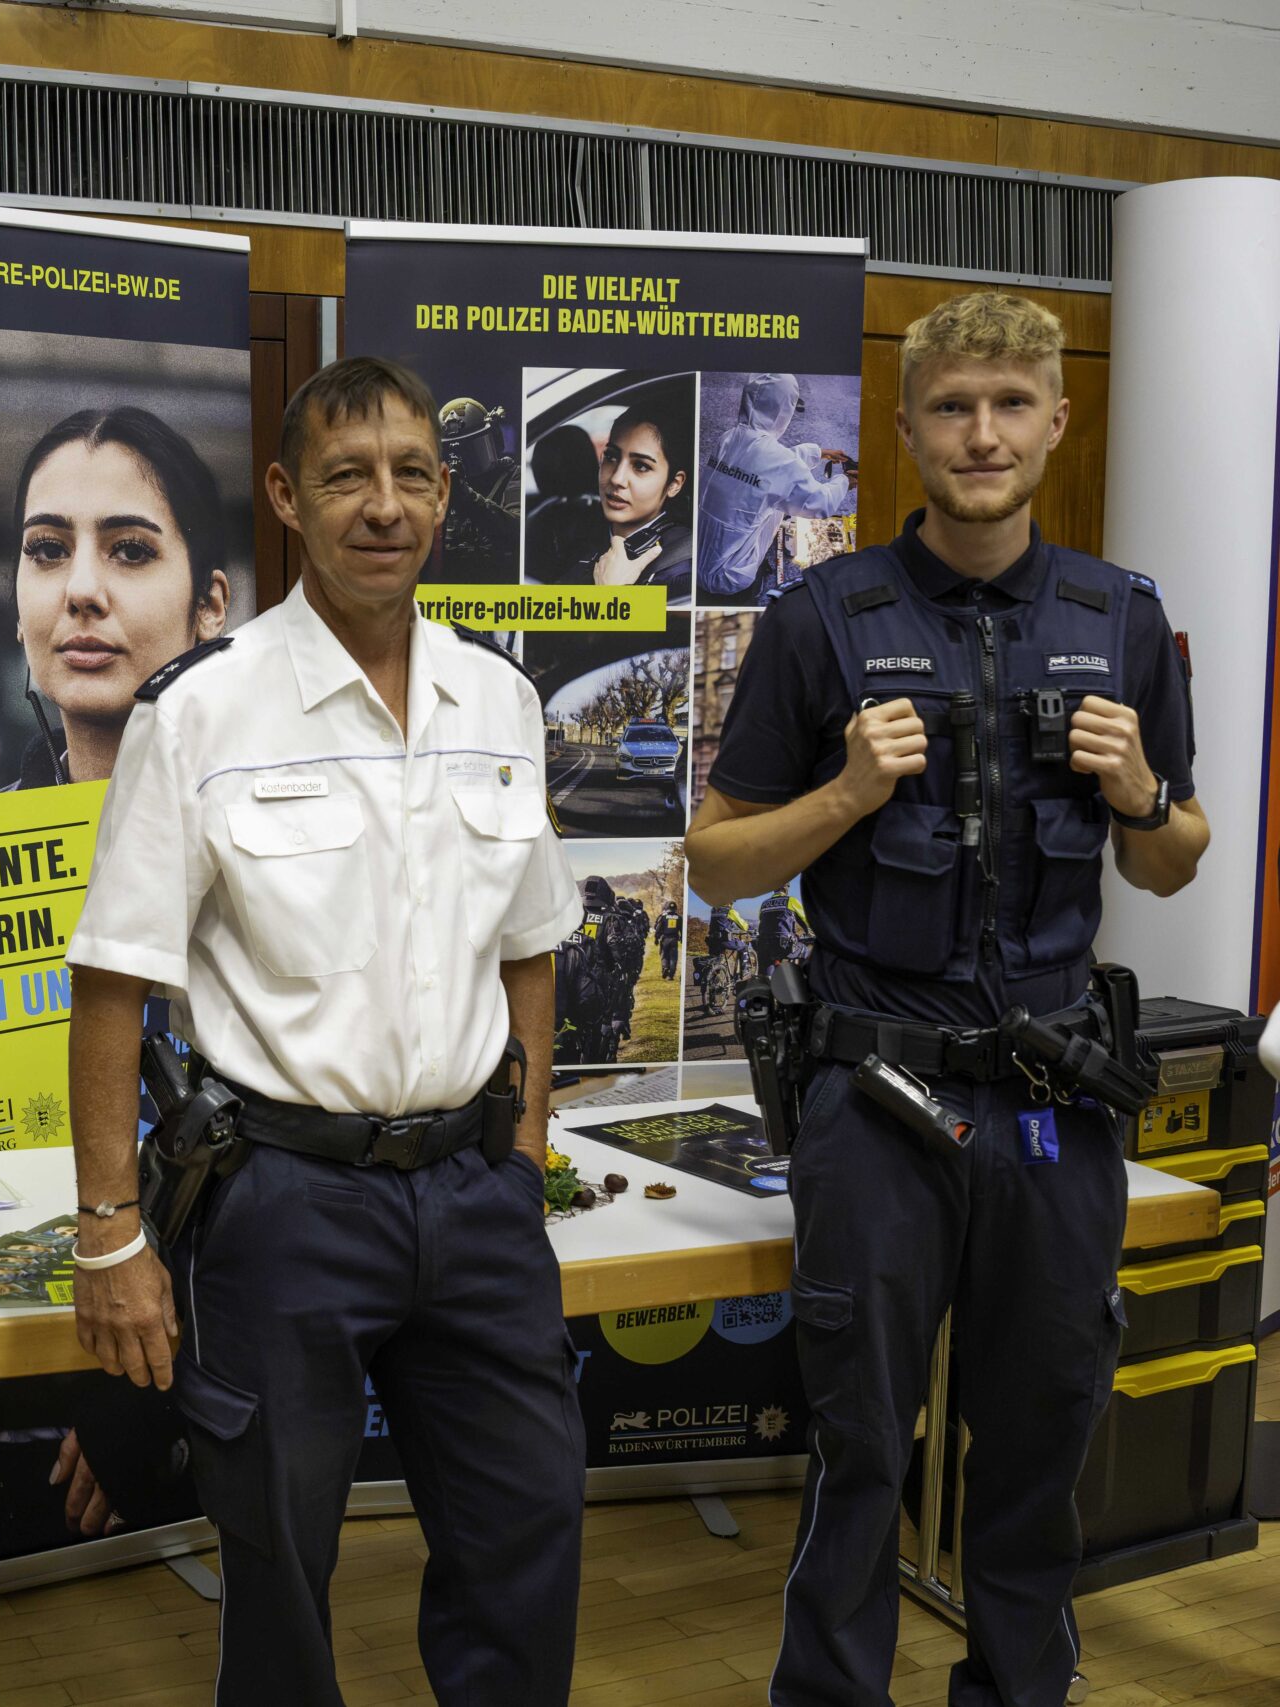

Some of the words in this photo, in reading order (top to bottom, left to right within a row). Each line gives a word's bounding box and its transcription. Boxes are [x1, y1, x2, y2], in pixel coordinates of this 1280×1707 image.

[543, 274, 577, 301] DIE
[585, 276, 680, 303] VIELFALT
[416, 304, 458, 330] DER
[466, 305, 550, 333] POLIZEI
[558, 305, 800, 339] BADEN-WÜRTTEMBERG
[417, 597, 631, 624] arriere-polizei-bw.de
[866, 657, 931, 671] PREISER
[1070, 654, 1108, 667] POLIZEI
[261, 781, 323, 794] Kostenbader
[20, 967, 72, 1016] UN
[601, 1118, 671, 1134] NACHT
[673, 1113, 718, 1125] DER
[616, 1303, 700, 1330] BEWERBEN.
[657, 1404, 748, 1428] POLIZEI
[608, 1435, 747, 1454] BADEN-WÜRTTEMBERG
